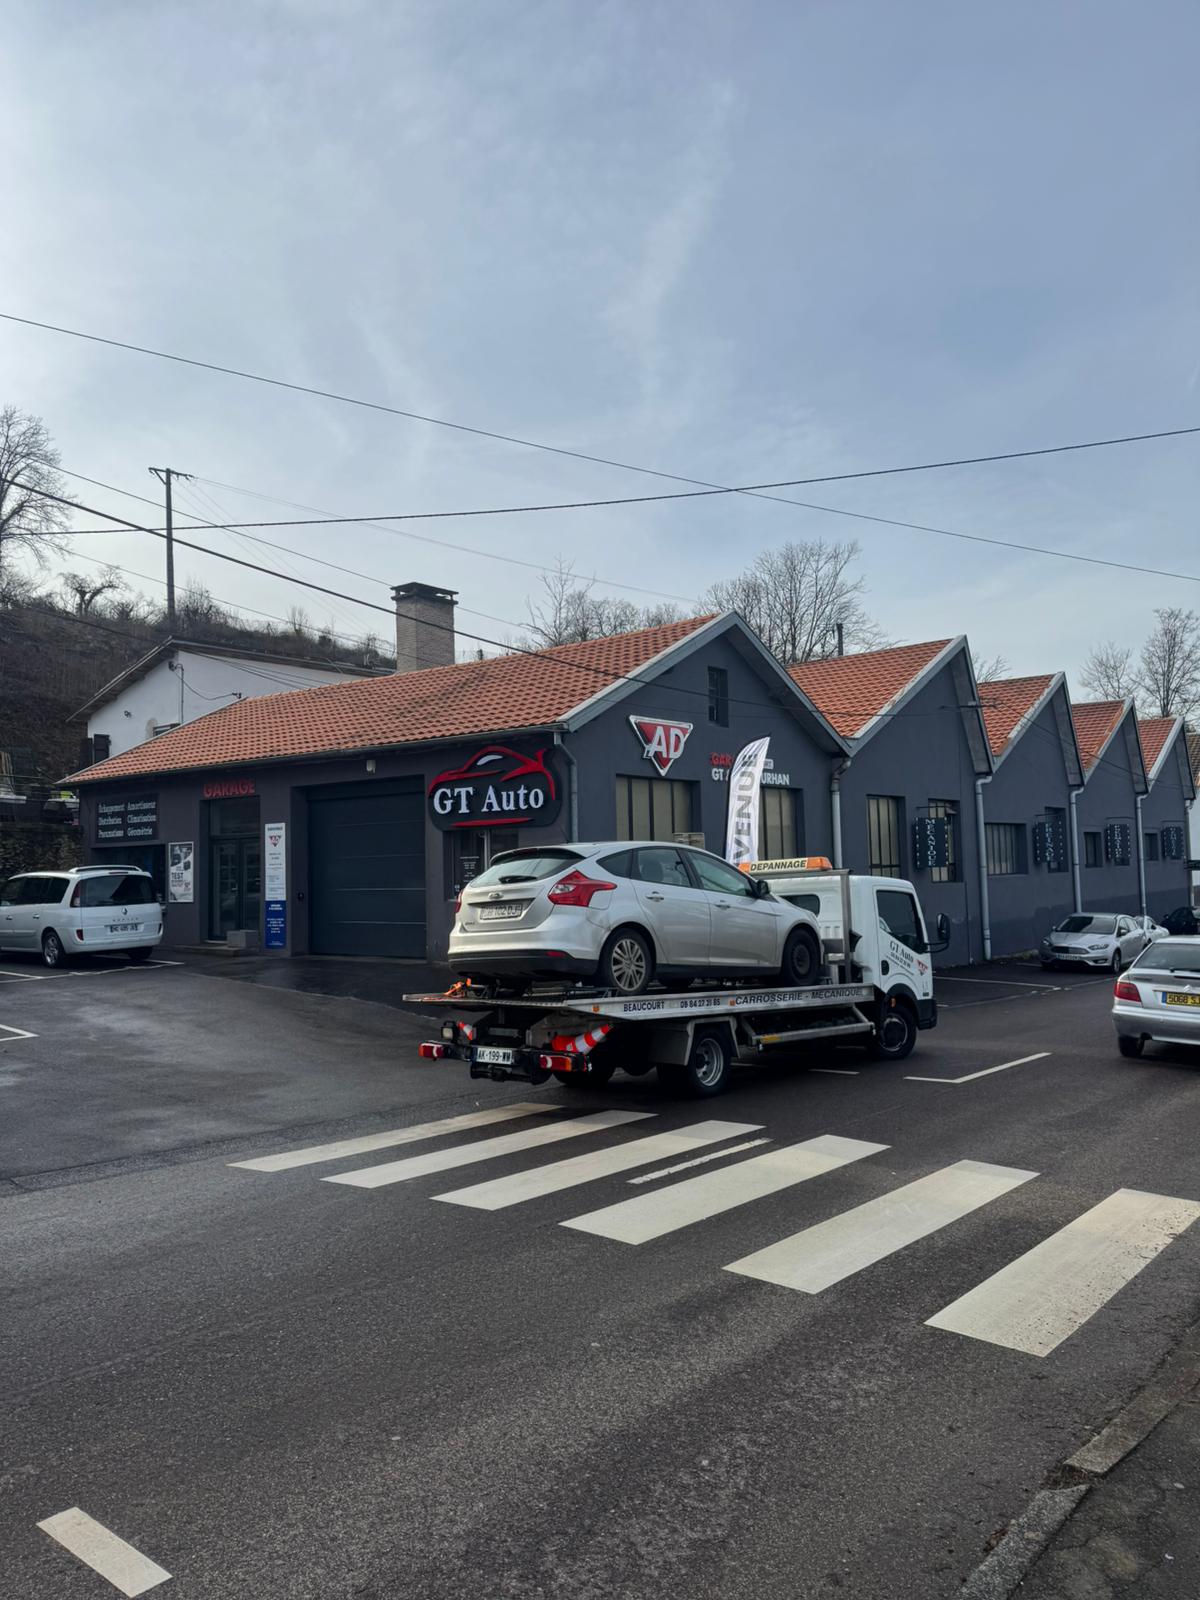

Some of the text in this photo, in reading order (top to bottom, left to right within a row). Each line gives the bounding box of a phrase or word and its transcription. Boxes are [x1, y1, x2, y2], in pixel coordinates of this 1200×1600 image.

[647, 726, 686, 759] AD
[711, 768, 725, 781] GT
[760, 772, 790, 786] URHAN
[202, 780, 256, 799] GARAGE
[433, 784, 545, 815] GT Auto
[733, 753, 757, 861] VENUE
[750, 860, 807, 872] DEPANNAGE
[735, 991, 803, 1005] CARROSSERIE
[811, 988, 862, 1000] MECANIQUE
[623, 1001, 665, 1012] BEAUCOURT
